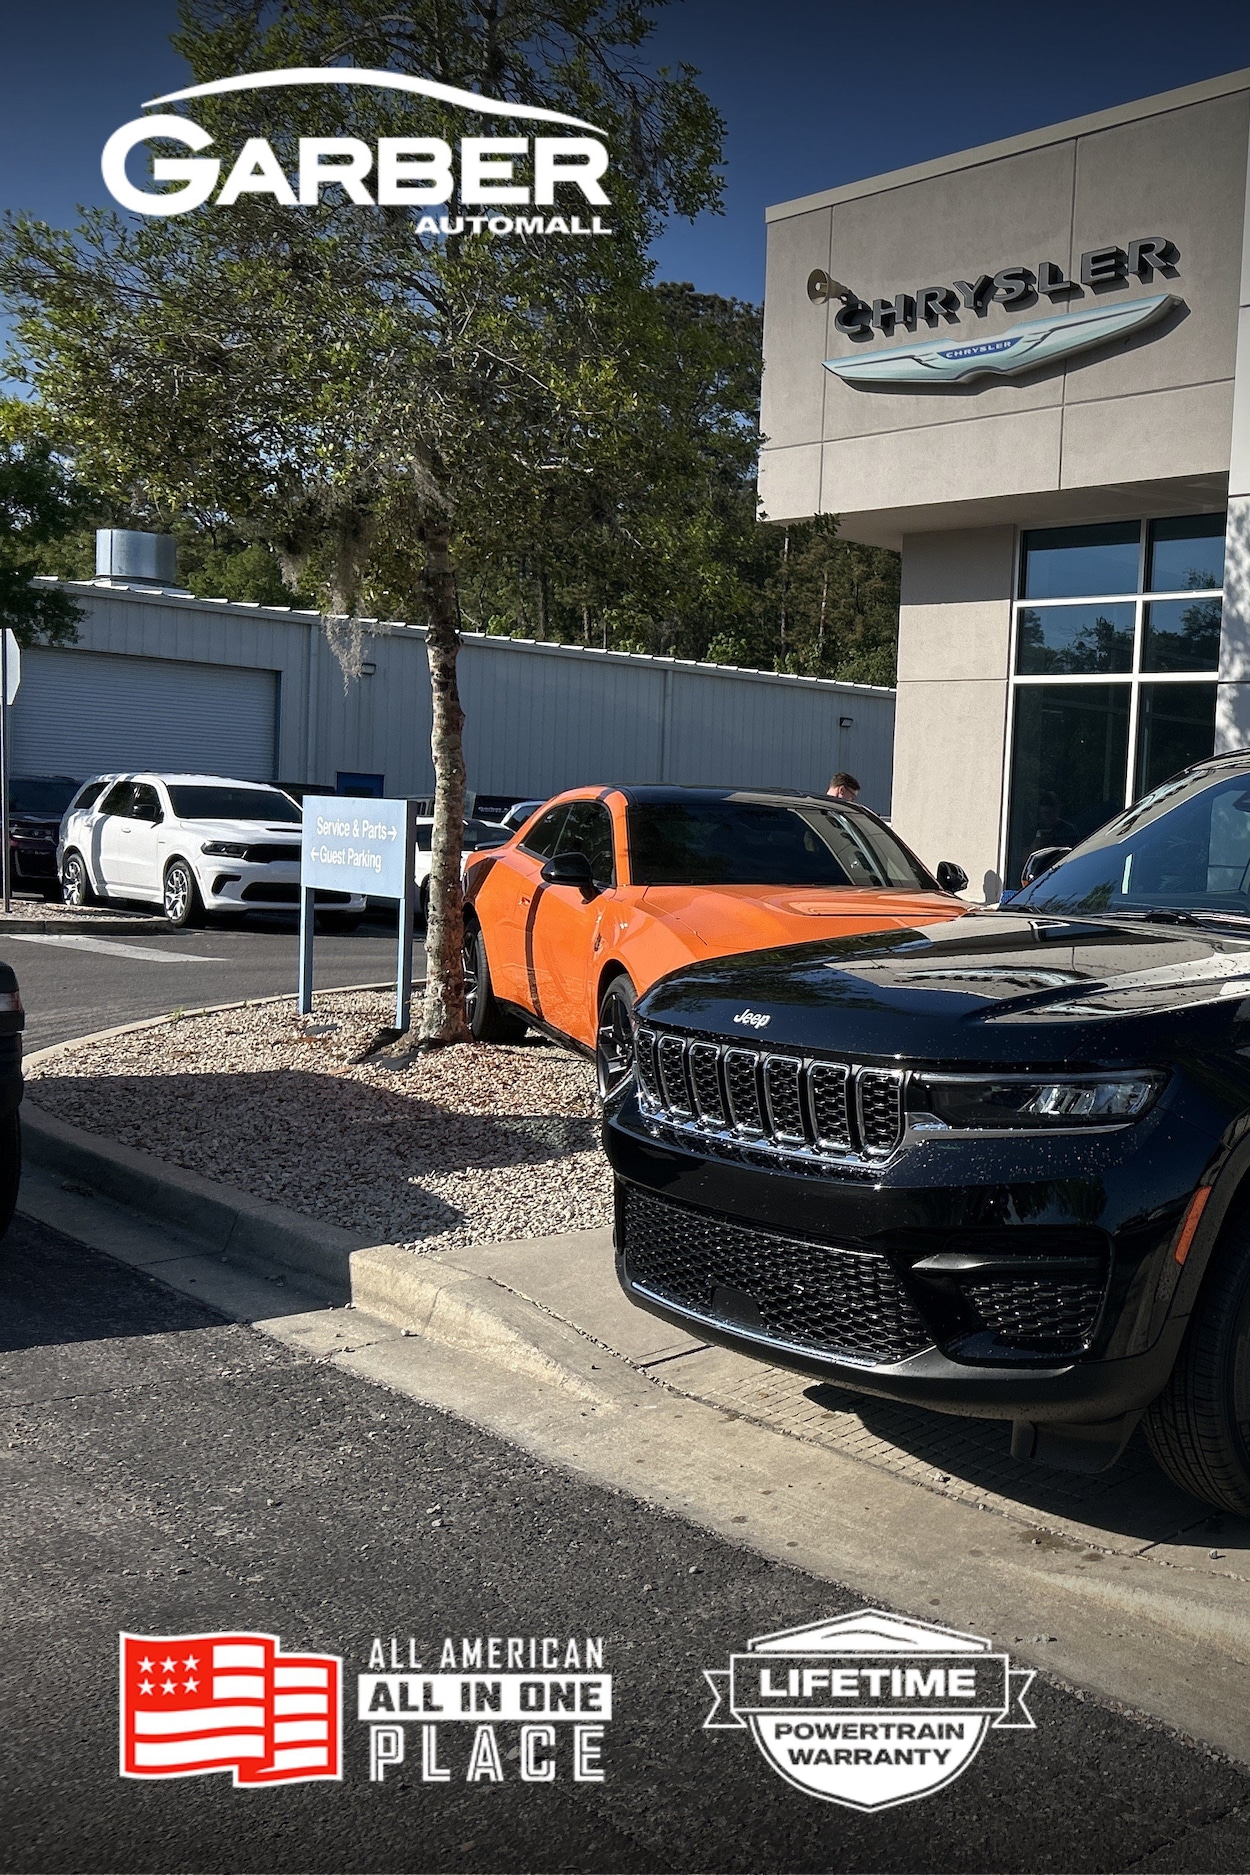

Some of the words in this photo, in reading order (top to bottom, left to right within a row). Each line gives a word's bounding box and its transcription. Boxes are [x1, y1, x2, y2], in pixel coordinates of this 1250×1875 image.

[835, 236, 1180, 341] CHRYSLER
[945, 339, 1012, 359] CHRYSLER
[316, 816, 350, 837] Service
[352, 819, 360, 838] &
[362, 820, 387, 840] Parts
[320, 845, 346, 865] Guest
[347, 848, 382, 873] Parking
[733, 1008, 771, 1029] Jeep
